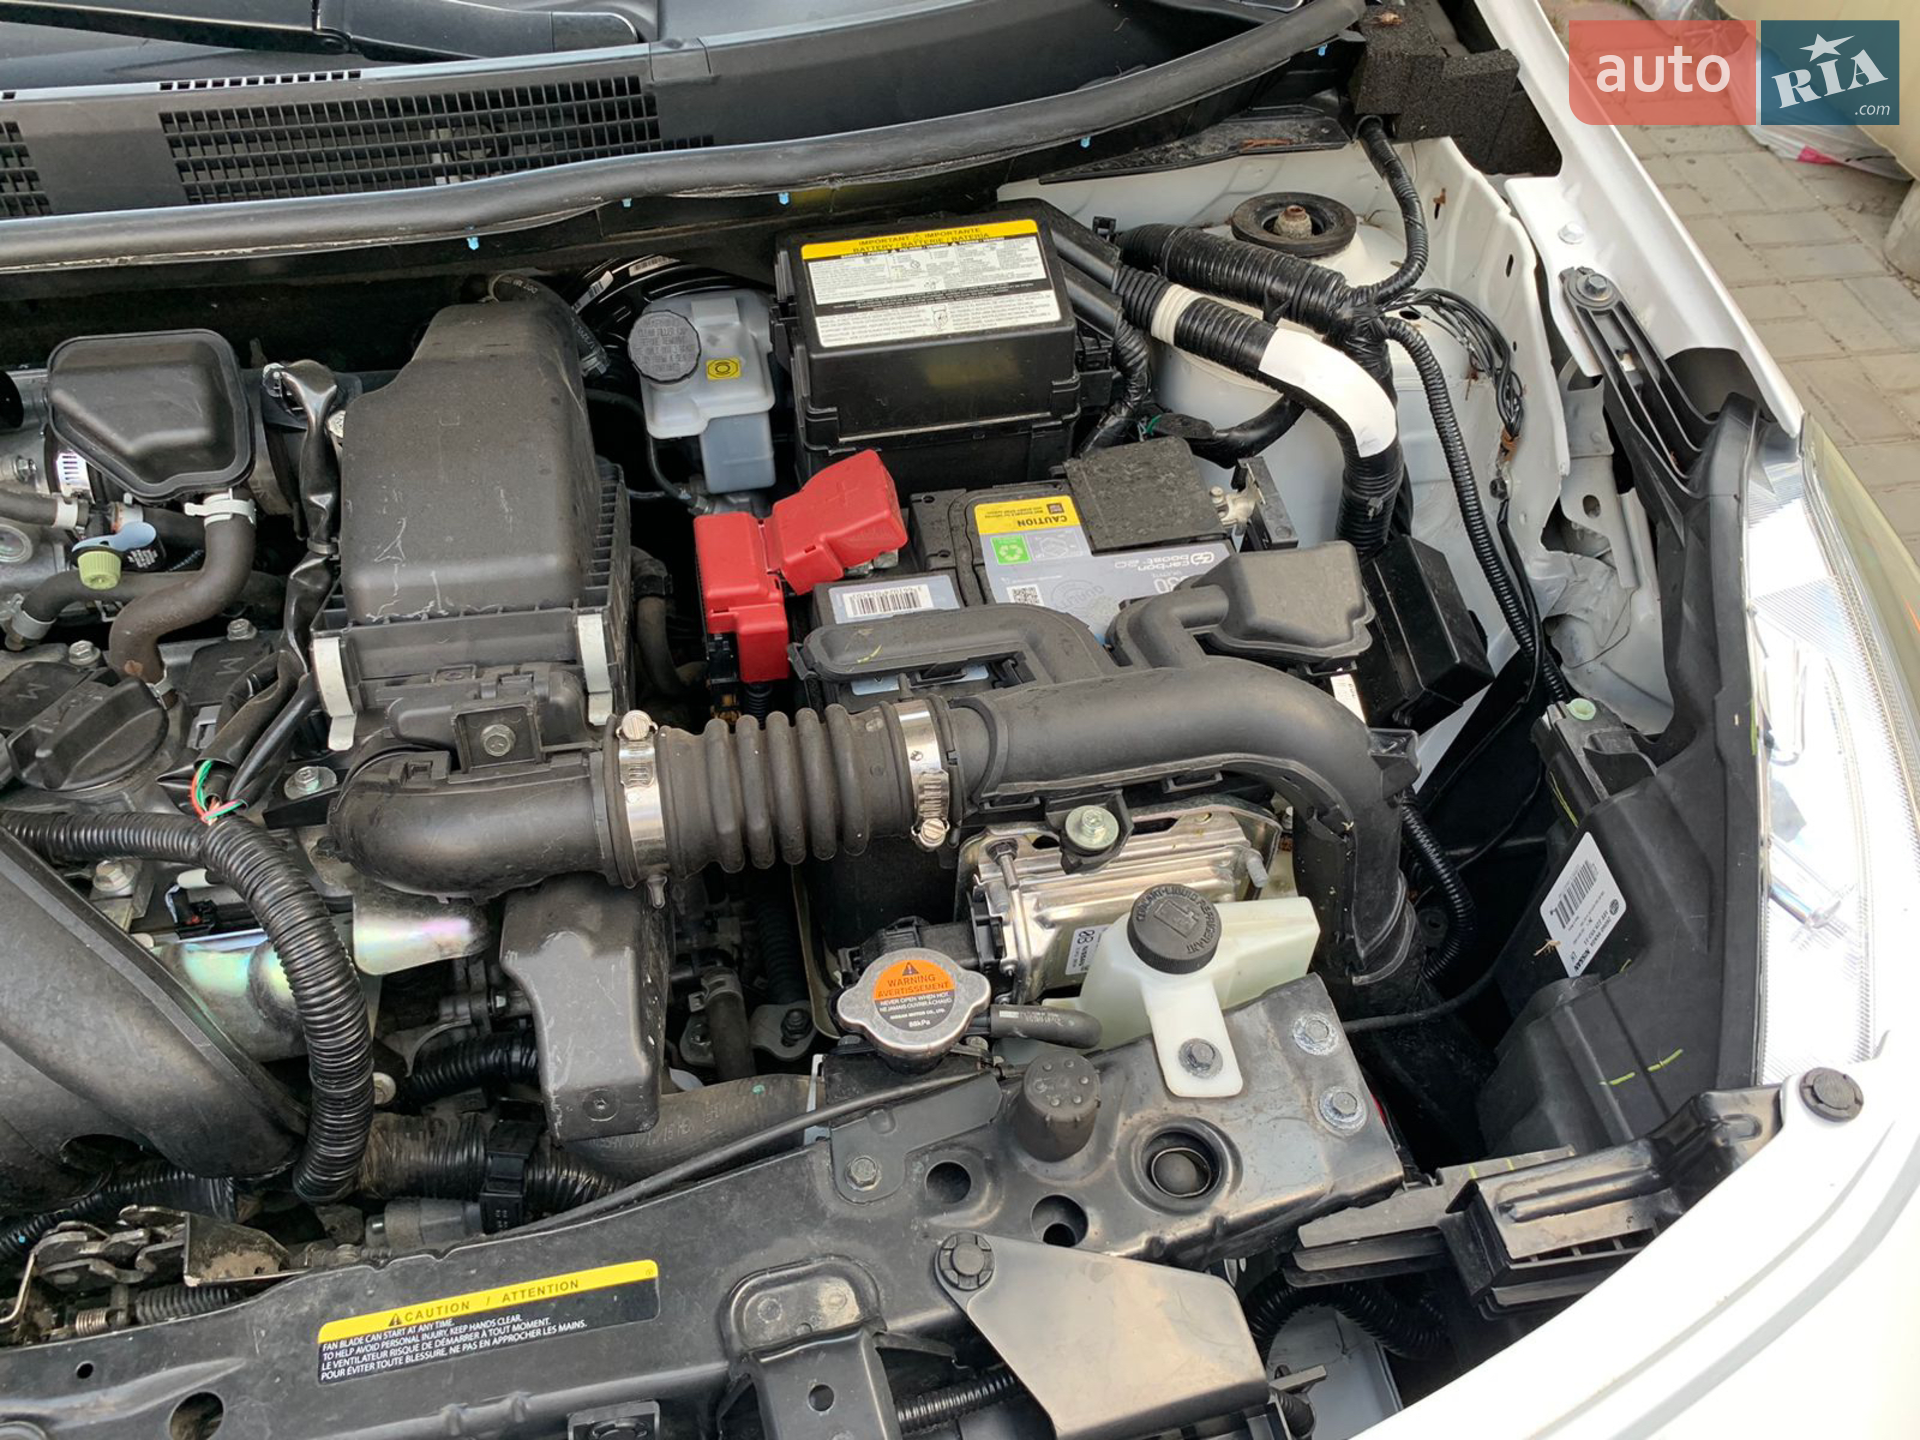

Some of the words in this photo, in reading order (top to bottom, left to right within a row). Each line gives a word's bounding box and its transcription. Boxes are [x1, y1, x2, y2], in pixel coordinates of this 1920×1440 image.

[853, 244, 893, 253] BATTERY
[900, 238, 943, 248] BATTERIE
[859, 236, 909, 246] IMPORTANT
[924, 228, 980, 238] IMPORTANTE
[1018, 516, 1068, 527] CAUTION
[878, 982, 949, 997] AVERTISSEMENT
[888, 974, 935, 987] WARNING
[880, 998, 900, 1006] NEVER
[901, 996, 917, 1004] OPEN
[918, 994, 936, 1002] WHEN
[406, 1300, 470, 1322] CAUTION
[502, 1280, 579, 1303] ATTENTION
[322, 1342, 338, 1352] FAN
[340, 1336, 364, 1349] BLADE
[365, 1334, 381, 1343] CAN
[383, 1328, 406, 1339] START
[407, 1326, 417, 1335] AT
[418, 1322, 434, 1332] ANY
[436, 1318, 455, 1329] TIME.
[322, 1361, 331, 1371] LE
[333, 1352, 389, 1369] VENTILATEUR
[389, 1345, 420, 1358] RISQUE
[421, 1341, 433, 1350] DE
[434, 1331, 480, 1348] DÉMARRER
[488, 1325, 511, 1337] TOUT
[511, 1317, 552, 1333] MOMENT.
[323, 1351, 334, 1360] TO
[336, 1347, 354, 1358] HELP
[355, 1343, 380, 1355] AVOID
[381, 1336, 419, 1350] PERSONAL
[449, 1324, 468, 1336] KEEP
[469, 1319, 496, 1332] HANDS
[321, 1367, 346, 1381] POUR
[347, 1361, 376, 1376] ÉVITER
[376, 1357, 404, 1369] TOUTE
[449, 1345, 461, 1355] NE
[462, 1342, 478, 1352] PAS
[479, 1338, 491, 1349] EN
[492, 1329, 542, 1346] APPROCHER
[543, 1325, 558, 1336] LES
[559, 1320, 587, 1333] MAINS.
